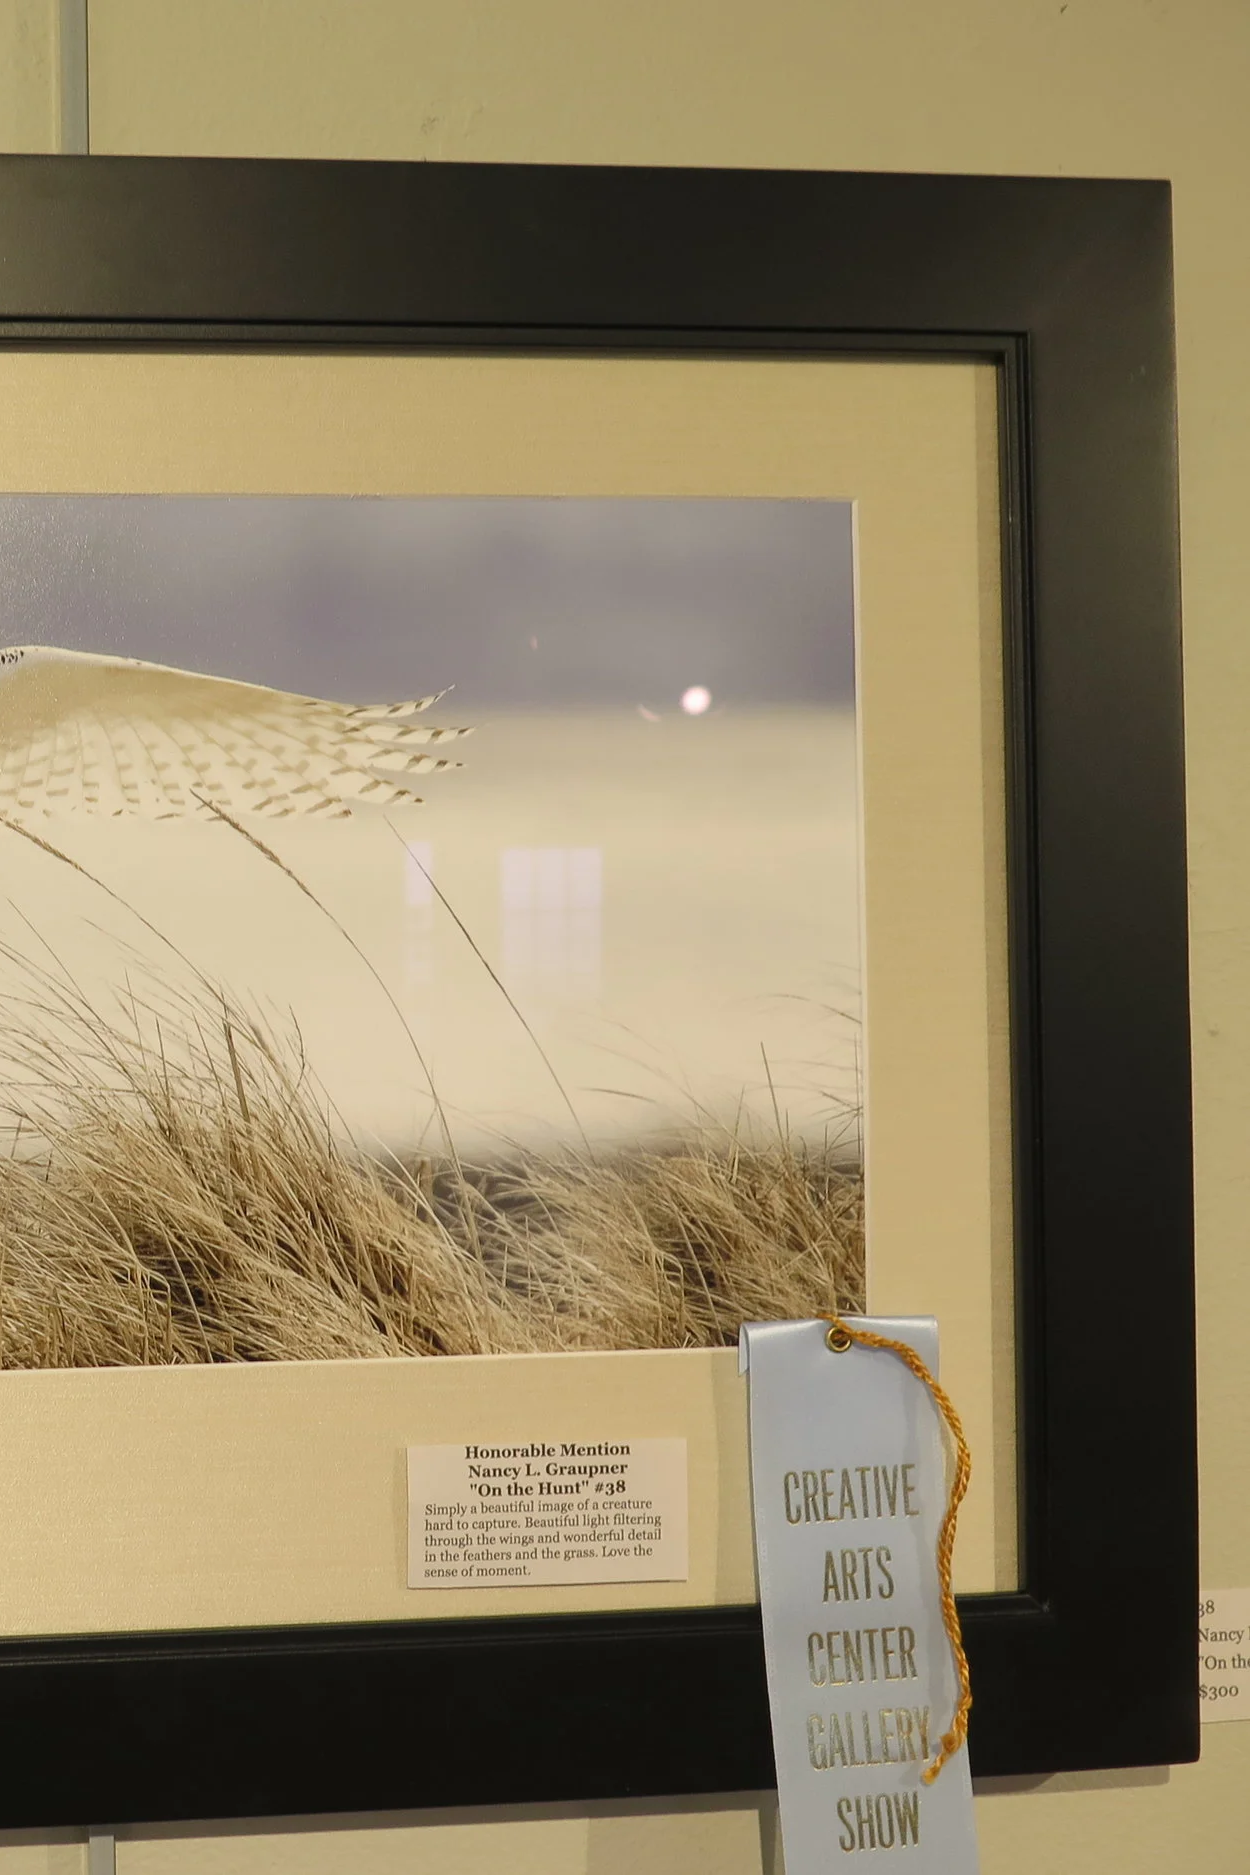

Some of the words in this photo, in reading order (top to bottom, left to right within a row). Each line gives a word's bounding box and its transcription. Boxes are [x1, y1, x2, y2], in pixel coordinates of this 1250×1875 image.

[465, 1443, 556, 1460] Honorable
[560, 1442, 631, 1457] Mention
[468, 1463, 521, 1480] Nancy
[525, 1463, 541, 1477] L.
[545, 1462, 628, 1477] Graupner
[469, 1483, 502, 1497] "On
[507, 1483, 534, 1496] the
[538, 1480, 589, 1495] Hunt"
[594, 1480, 626, 1496] #38
[783, 1463, 920, 1526] CREATIVE
[425, 1503, 468, 1517] Simply
[470, 1506, 477, 1515] a
[481, 1500, 534, 1514] beautiful
[537, 1501, 574, 1515] image
[577, 1499, 591, 1511] of
[592, 1501, 599, 1510] a
[602, 1499, 653, 1510] creature
[424, 1519, 453, 1531] hard
[457, 1520, 469, 1530] to
[471, 1518, 521, 1532] capture.
[525, 1515, 580, 1529] Beautiful
[582, 1514, 610, 1528] light
[612, 1514, 662, 1527] filtering
[424, 1534, 473, 1548] through
[476, 1533, 496, 1546] the
[499, 1533, 535, 1546] wings
[537, 1531, 560, 1544] and
[563, 1529, 625, 1543] wonderful
[628, 1528, 662, 1541] detail
[424, 1551, 437, 1562] in
[440, 1551, 460, 1562] the
[463, 1549, 512, 1561] feathers
[514, 1547, 538, 1560] and
[541, 1547, 561, 1559] the
[563, 1548, 599, 1562] grass.
[602, 1546, 631, 1557] Love
[633, 1545, 653, 1556] the
[424, 1567, 458, 1577] sense
[461, 1565, 476, 1577] of
[476, 1566, 531, 1577] moment.
[822, 1545, 895, 1603] ARTS
[1198, 1628, 1244, 1644] Nancy
[807, 1625, 918, 1688] CENTER
[1199, 1683, 1239, 1700] $300
[806, 1704, 930, 1773] GALLERY
[838, 1791, 922, 1854] SHOW
